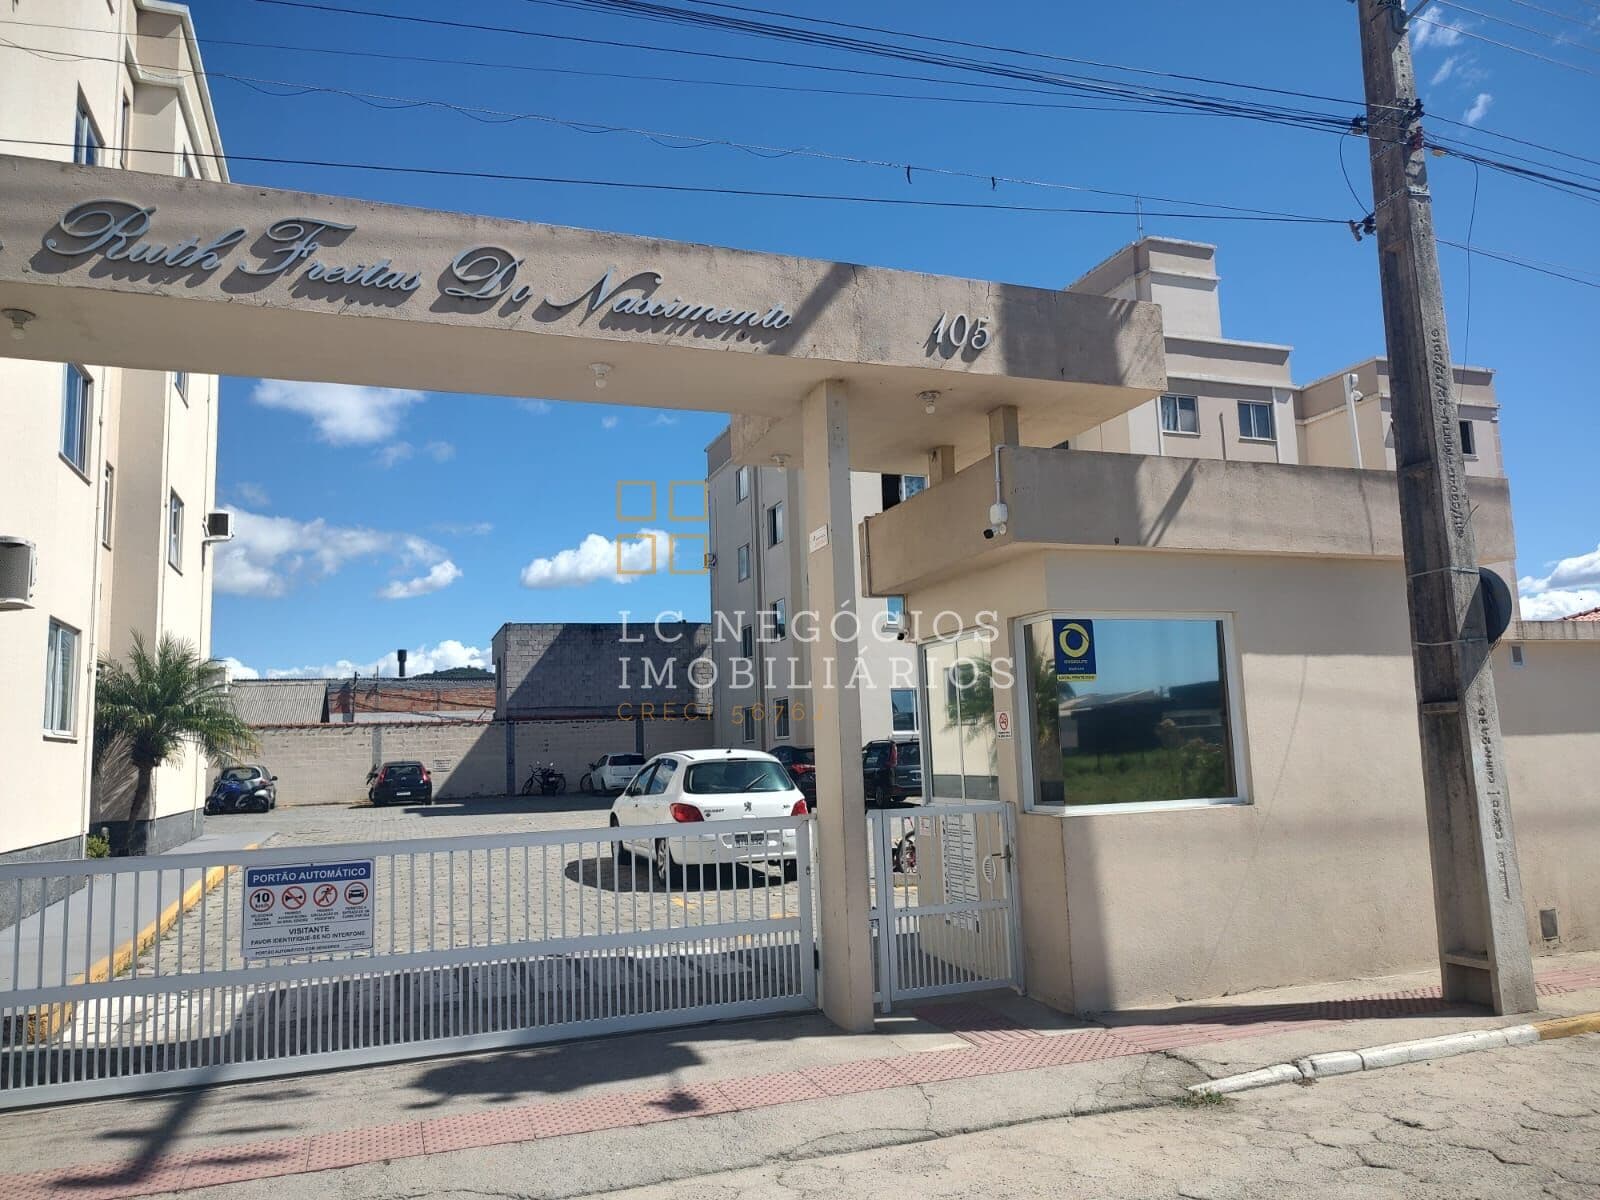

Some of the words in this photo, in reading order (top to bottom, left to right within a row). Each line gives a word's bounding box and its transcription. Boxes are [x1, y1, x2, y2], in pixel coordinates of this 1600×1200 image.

[46, 197, 248, 270] Ruth
[239, 217, 423, 292] Freitas
[445, 245, 533, 302] Do
[545, 264, 793, 329] Nascimento
[933, 311, 992, 350] 105
[253, 872, 297, 883] PORTÃO
[298, 867, 366, 881] AUTOMÁTICO
[254, 892, 270, 903] 10
[288, 925, 330, 935] VISITANTE
[250, 938, 272, 946] FAVOR
[272, 935, 320, 944] IDENTIFIQUE-SE
